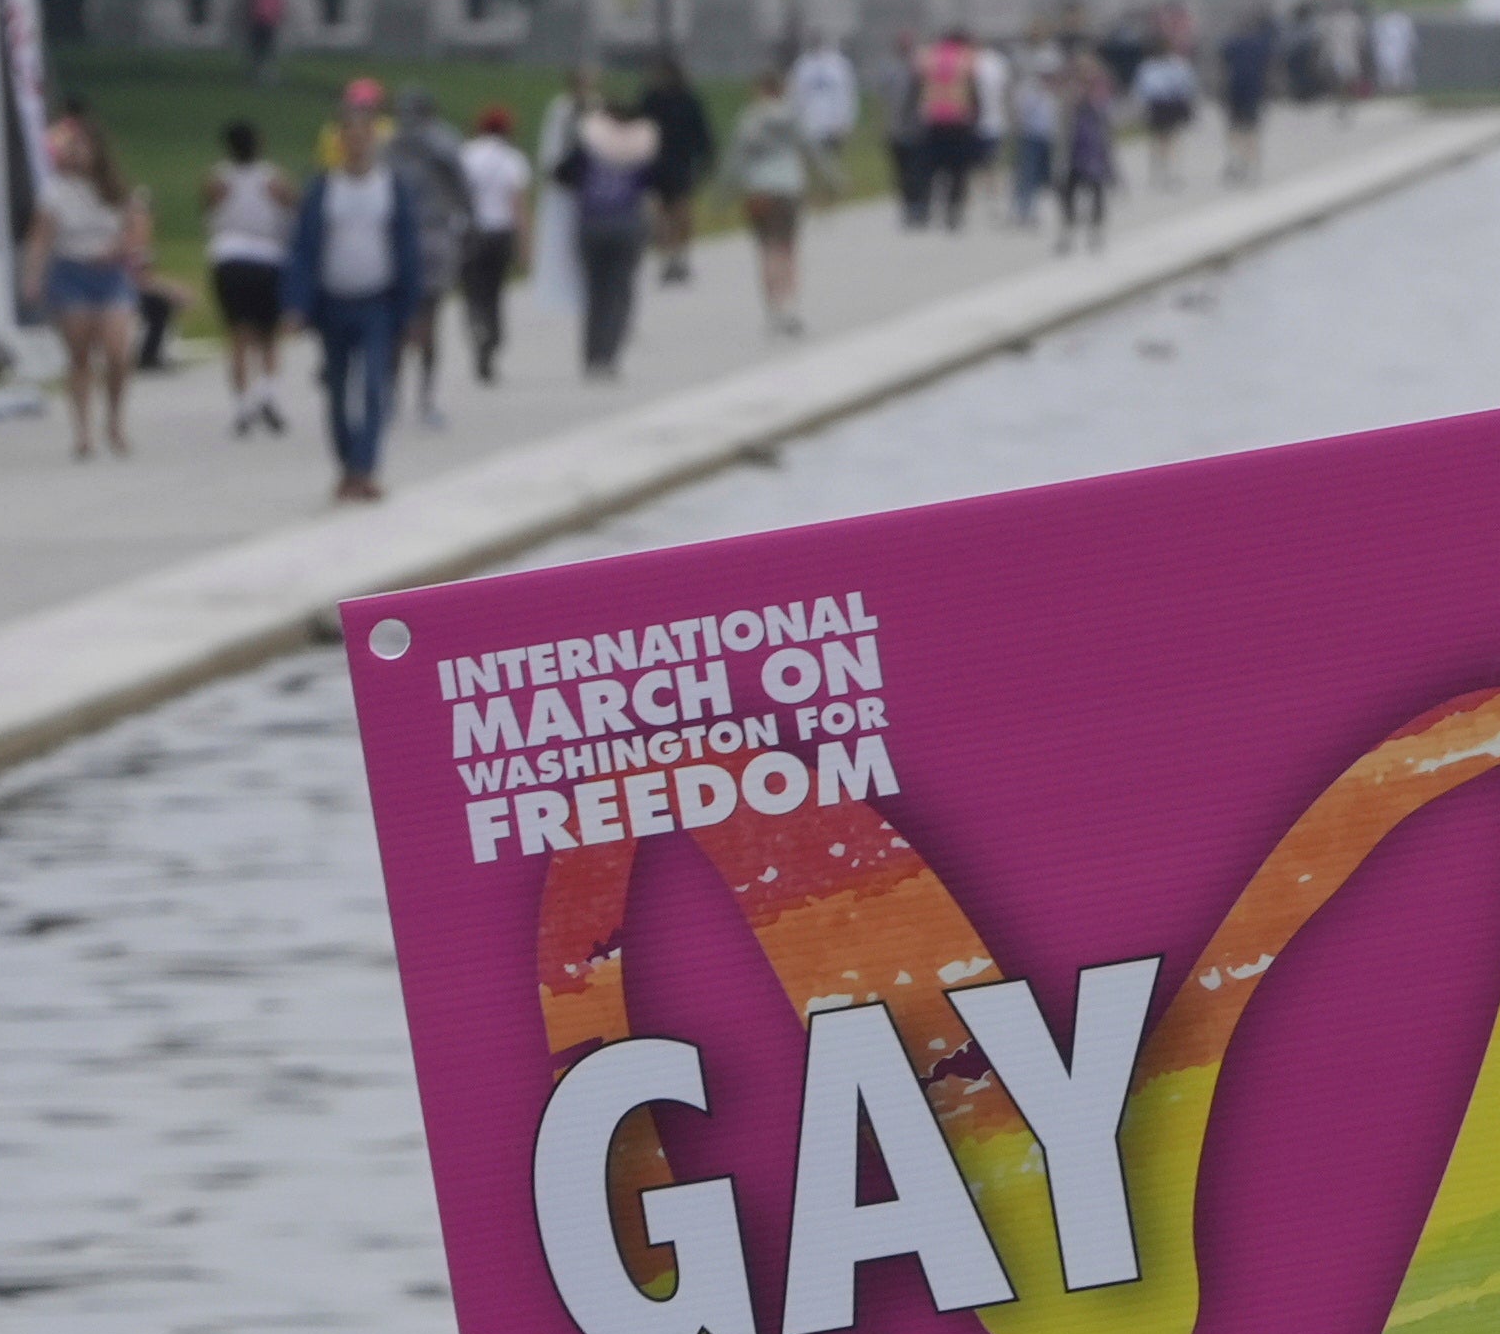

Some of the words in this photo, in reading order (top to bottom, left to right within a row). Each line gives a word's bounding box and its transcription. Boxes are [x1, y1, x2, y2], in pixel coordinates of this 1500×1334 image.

[436, 590, 880, 702] INTERNATIONAL
[451, 658, 734, 760] MARCH
[760, 633, 884, 705] ON
[456, 712, 780, 797] WASHINGTON
[794, 695, 890, 742] FOR
[464, 733, 902, 865] FREEDOM
